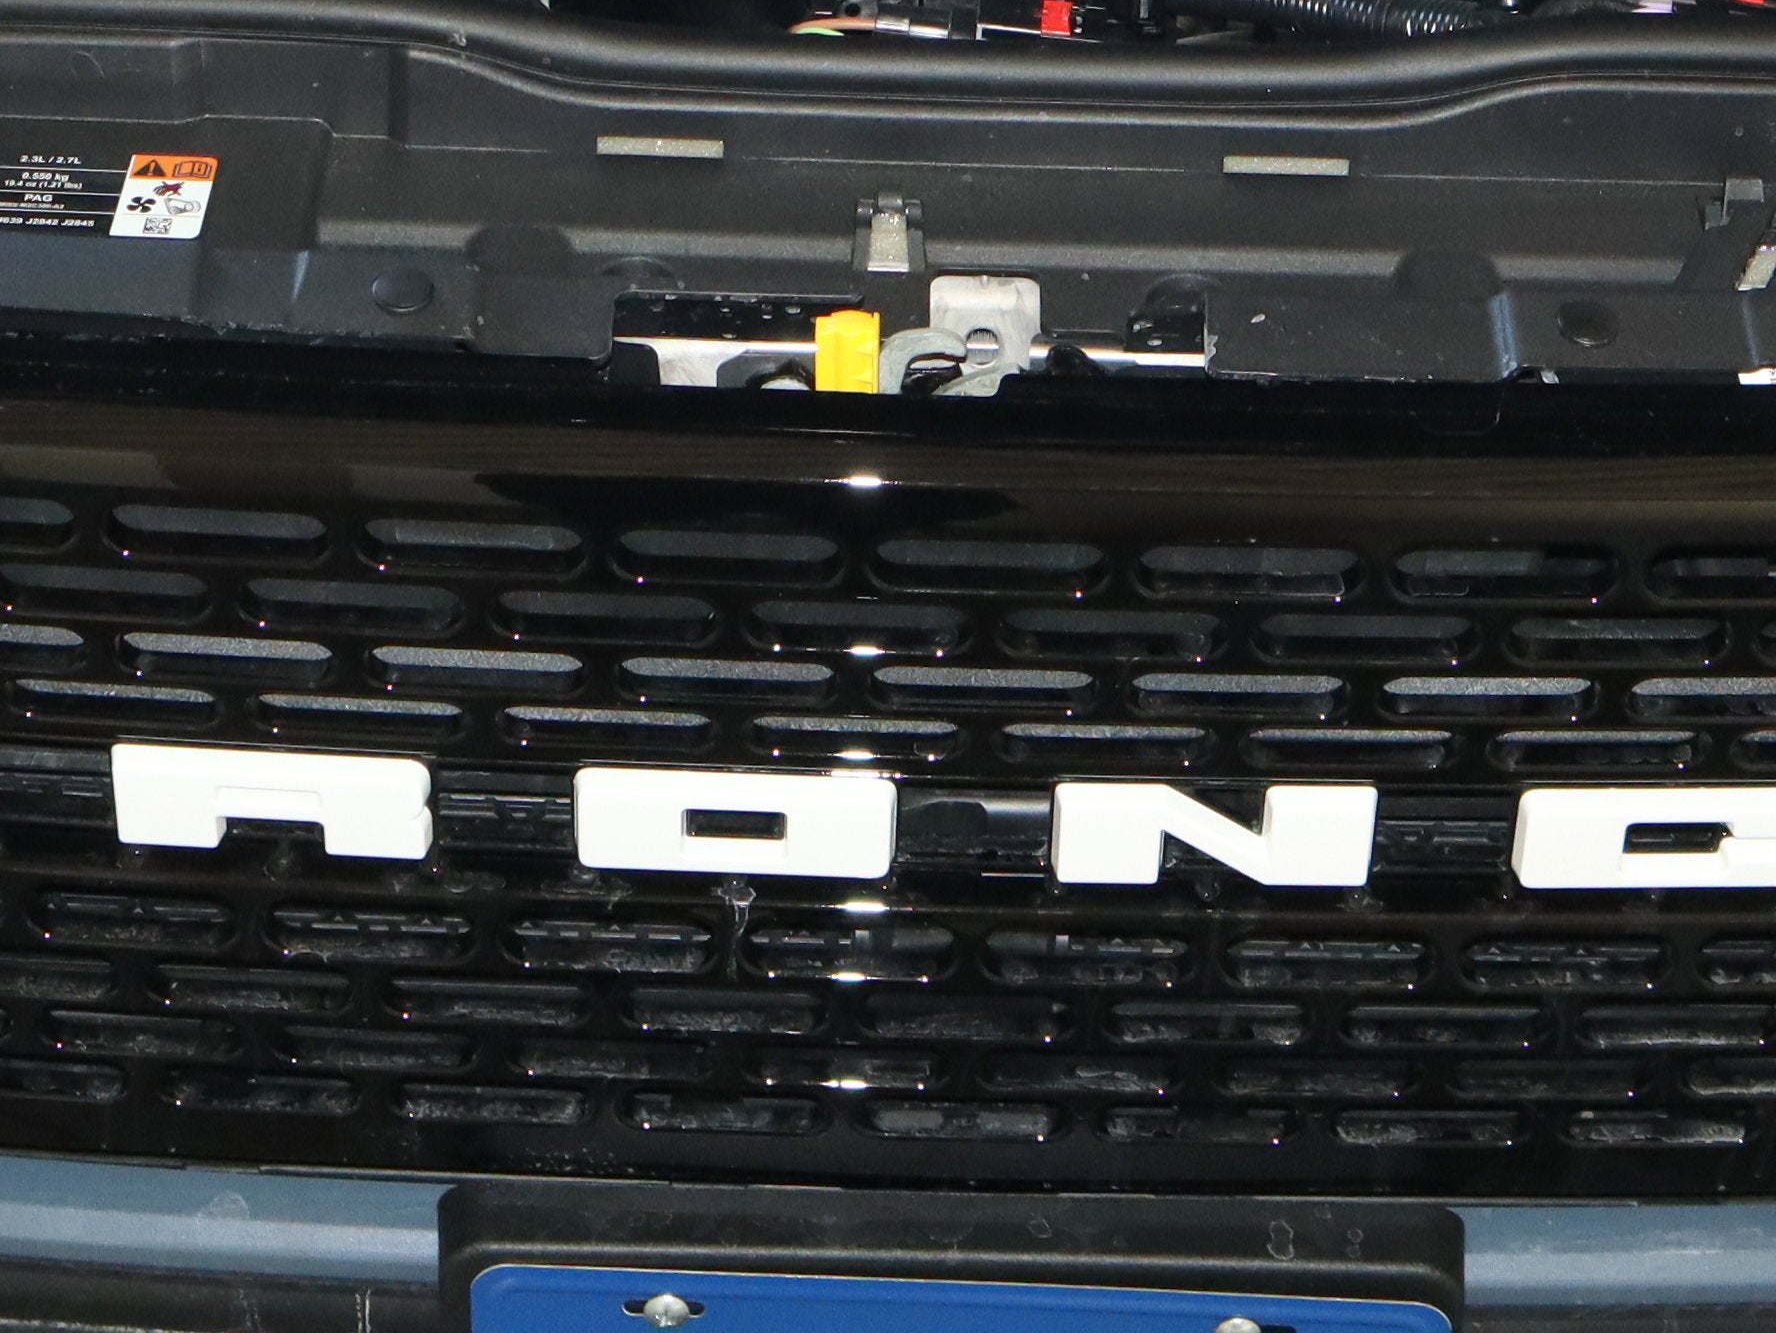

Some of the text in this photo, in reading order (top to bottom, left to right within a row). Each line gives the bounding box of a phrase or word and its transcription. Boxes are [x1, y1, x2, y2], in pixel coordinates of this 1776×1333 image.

[20, 154, 46, 164] 2.3L
[55, 156, 82, 165] 2.7L
[24, 193, 53, 202] PAG
